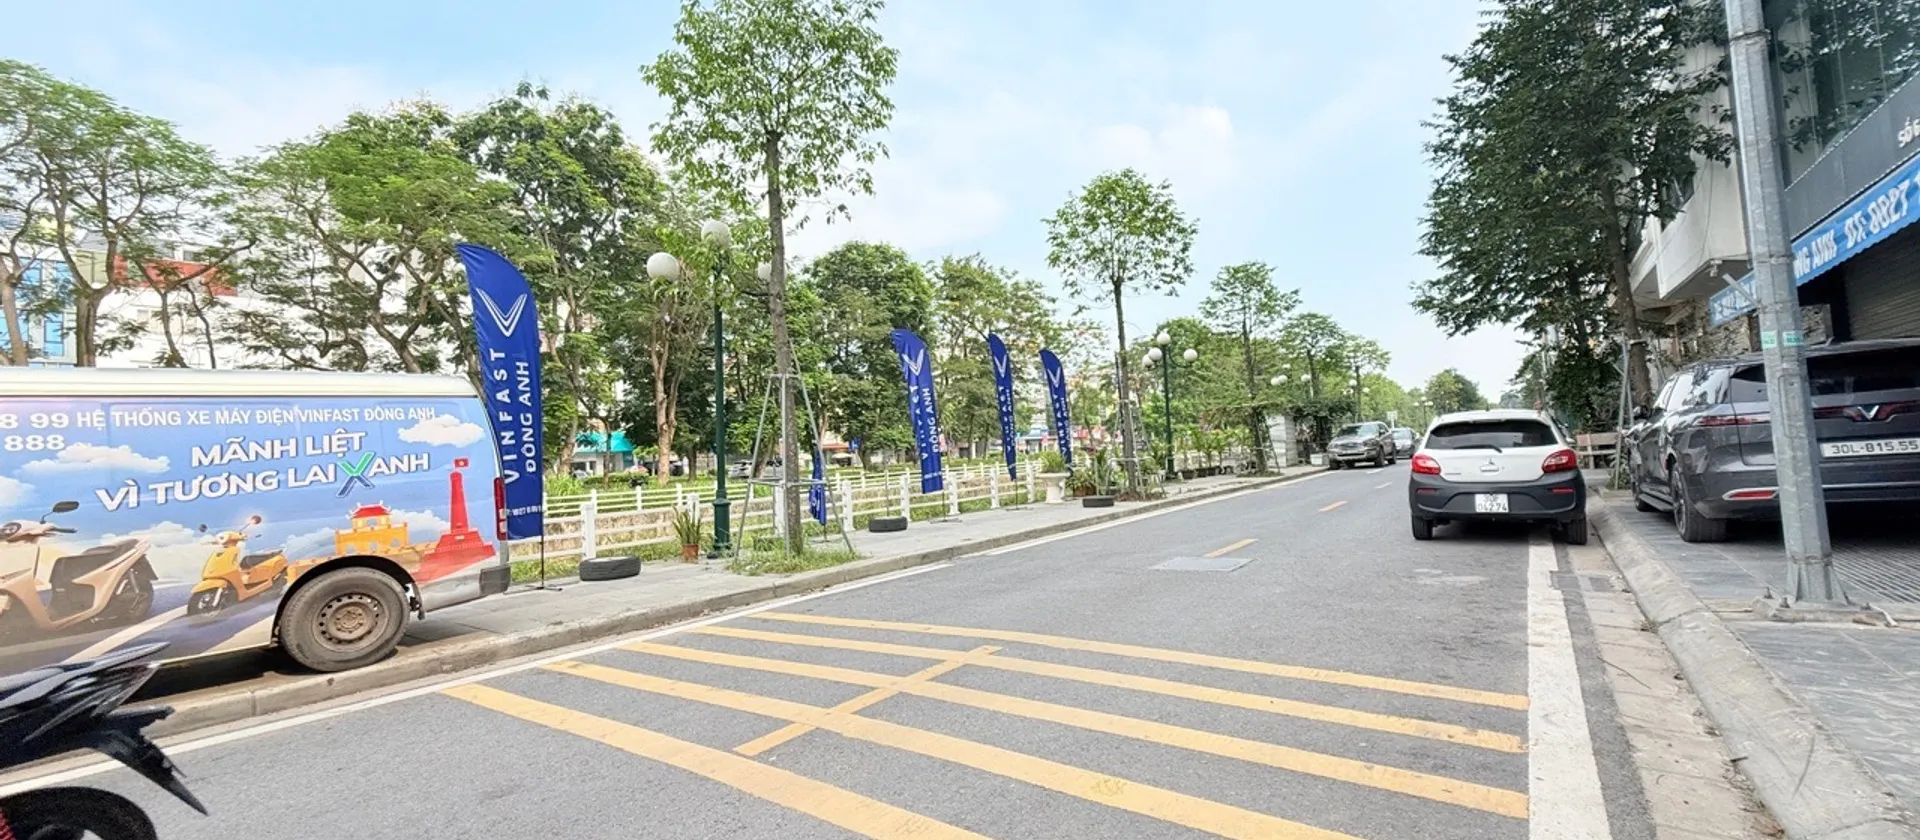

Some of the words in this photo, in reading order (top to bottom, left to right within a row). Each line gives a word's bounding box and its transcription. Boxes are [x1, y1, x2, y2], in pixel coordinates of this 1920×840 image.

[515, 361, 532, 406] ANH
[489, 348, 521, 484] VINFAST
[922, 387, 934, 414] ANH
[30, 412, 70, 429] 99
[76, 408, 106, 431] HỆ
[111, 406, 182, 427] THỐNG
[187, 410, 211, 425] XE
[215, 407, 251, 425] MÁY
[255, 408, 294, 426] ĐIỆN
[299, 408, 360, 424] VINFAST
[364, 406, 404, 422] ĐÔNG
[407, 407, 435, 421] ANH
[4, 434, 65, 452] 888
[191, 436, 298, 468] MÃNH
[305, 428, 367, 458] LIỆT
[520, 412, 537, 473] ĐÔNG
[1831, 440, 1919, 454] 30L-815.55
[95, 478, 140, 512] VÌ
[149, 470, 279, 505] TƯƠNG
[287, 463, 337, 489] LAI
[335, 451, 430, 499] XANH
